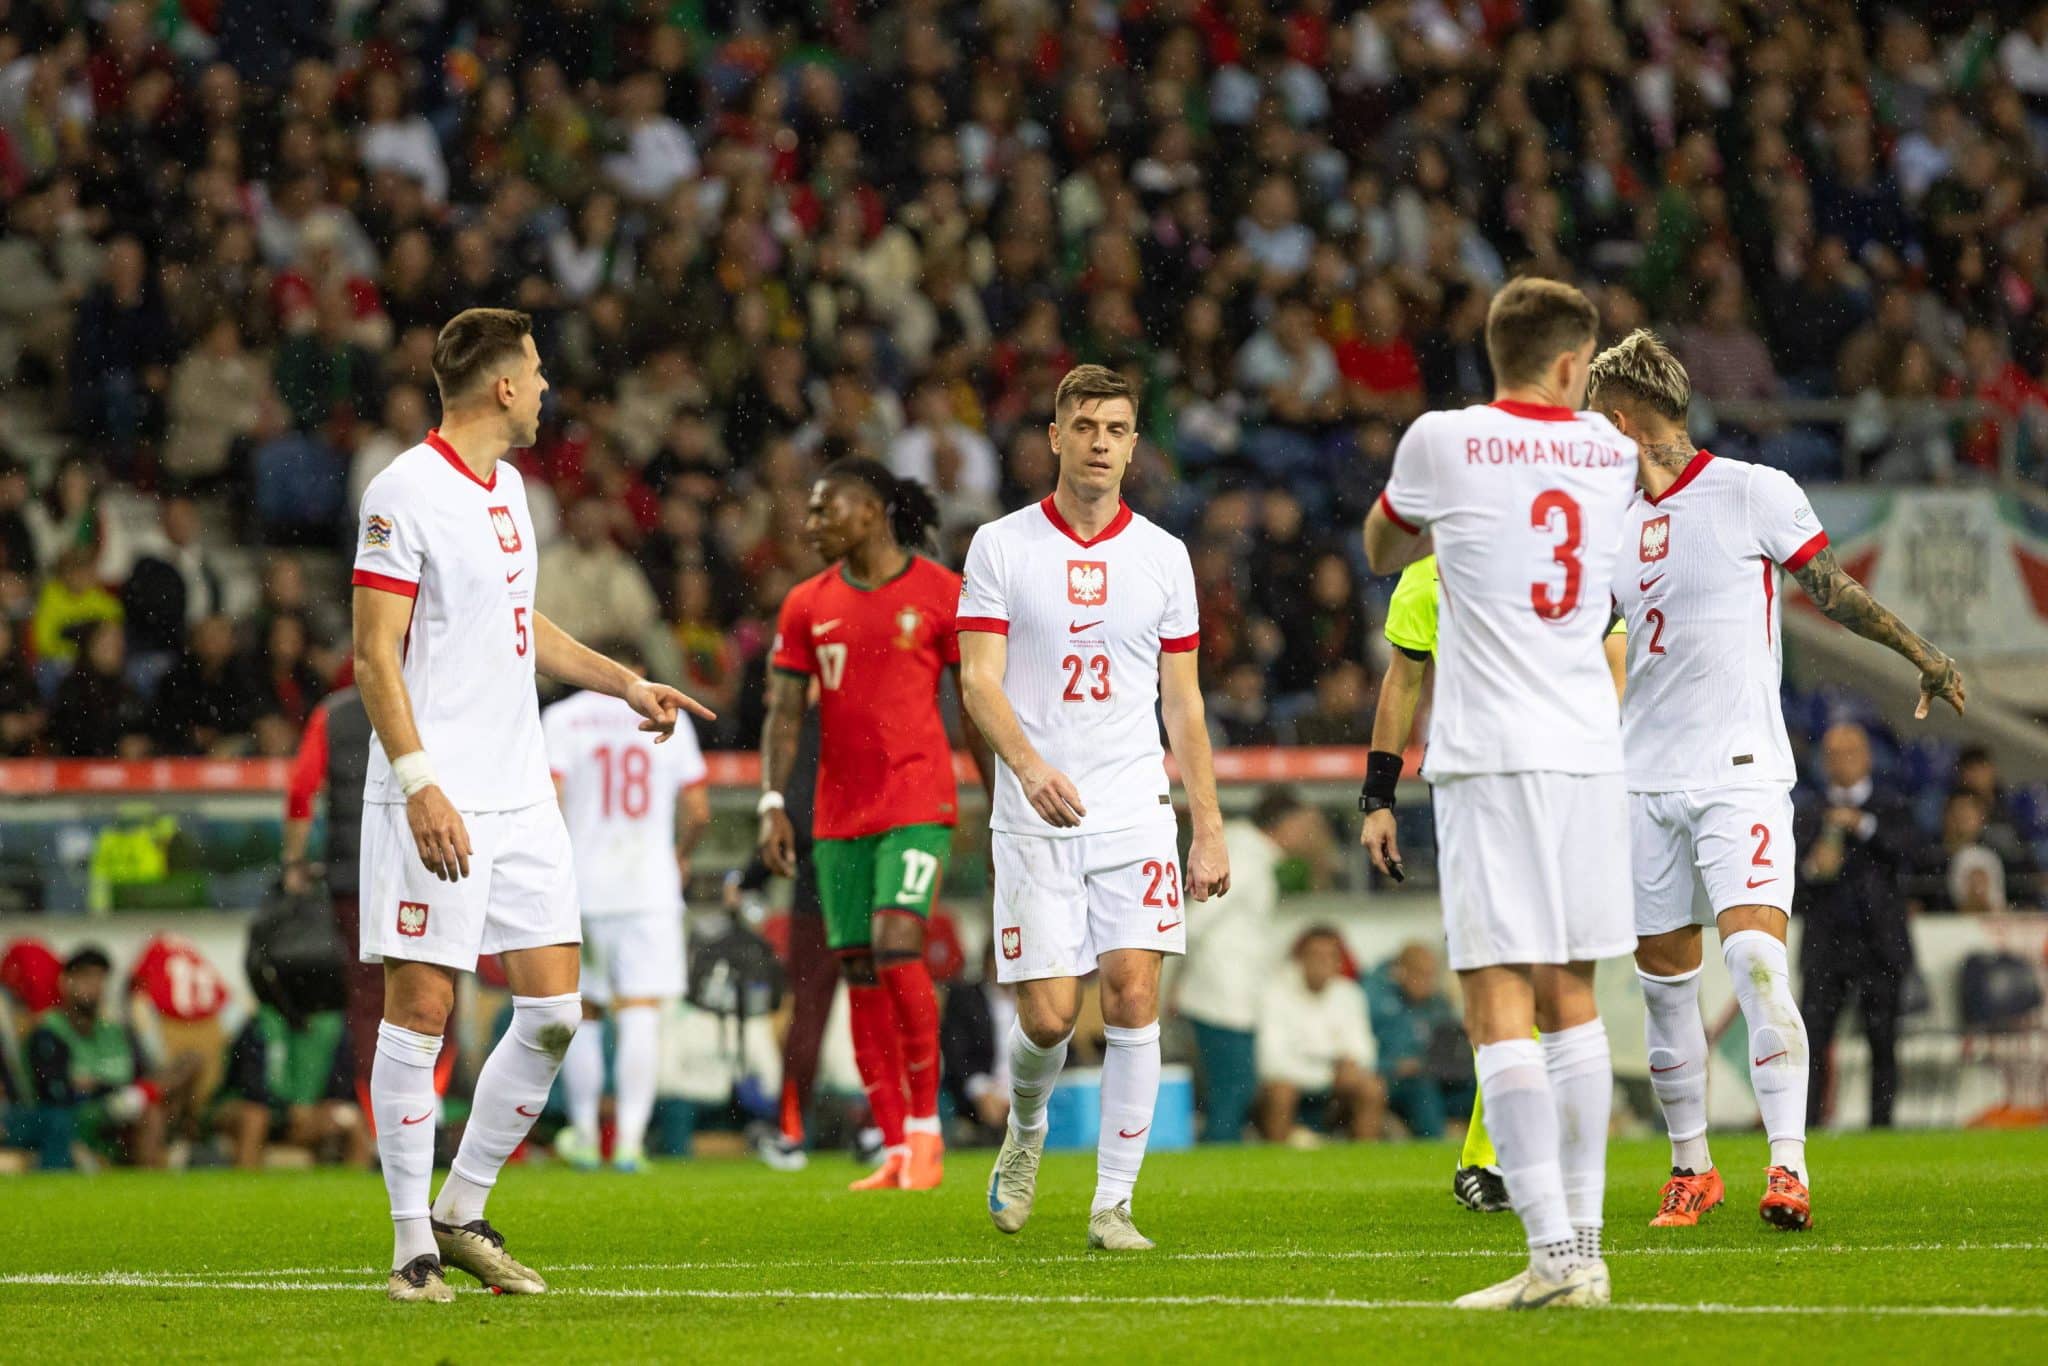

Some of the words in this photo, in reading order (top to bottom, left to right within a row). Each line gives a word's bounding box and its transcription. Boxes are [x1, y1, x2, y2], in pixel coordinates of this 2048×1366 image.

[1530, 488, 1585, 623] 3
[514, 607, 527, 657] 5
[1645, 611, 1667, 655] 2
[815, 641, 848, 691] 17
[1062, 654, 1111, 702] 23
[592, 743, 651, 820] 18
[1750, 823, 1773, 868] 2
[902, 848, 938, 894] 17
[1142, 860, 1179, 908] 23
